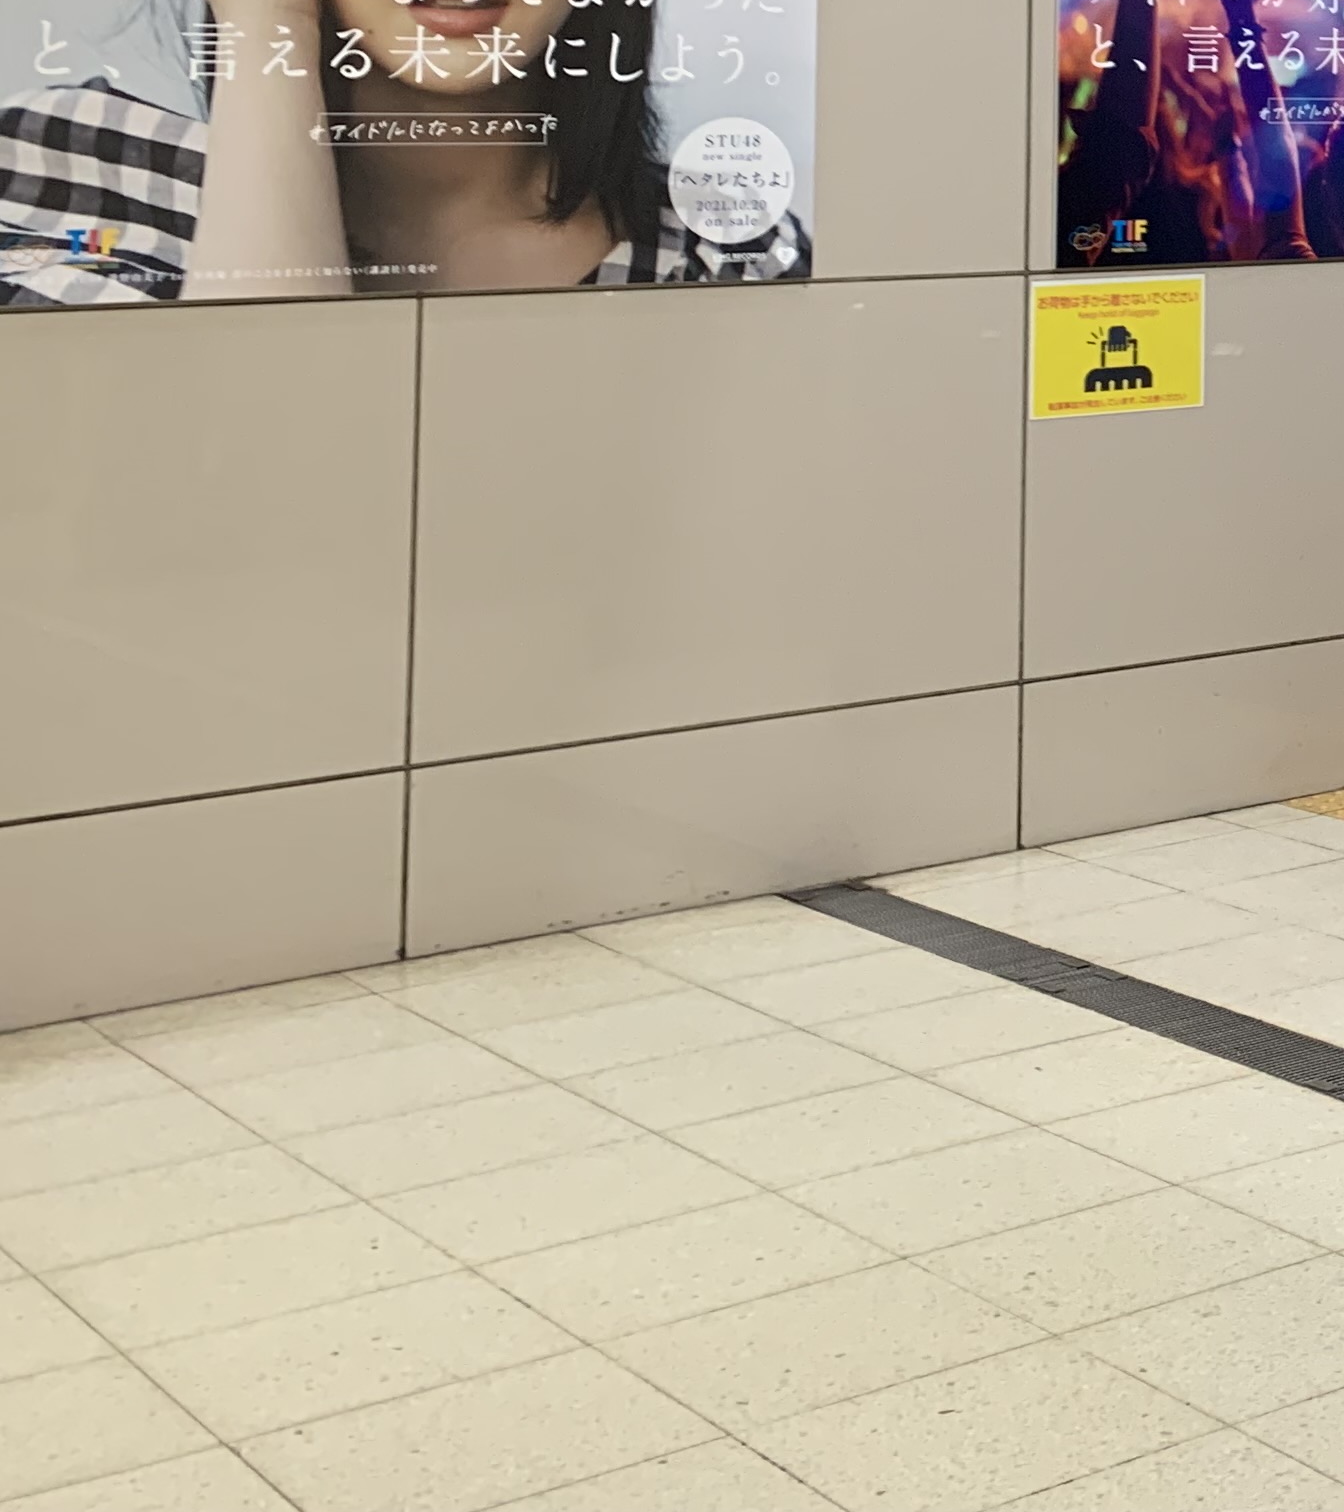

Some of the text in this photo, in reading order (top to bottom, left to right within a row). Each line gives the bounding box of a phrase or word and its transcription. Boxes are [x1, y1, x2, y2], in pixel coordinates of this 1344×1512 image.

[30, 18, 783, 89] と、言える未来にしよう。
[704, 134, 761, 148] STU48
[674, 171, 789, 188] 「ヘタレたちよ」
[696, 199, 767, 212] 2021.10.20
[705, 215, 759, 227] on sale
[1112, 219, 1148, 242] TIF
[65, 229, 120, 255] TIF
